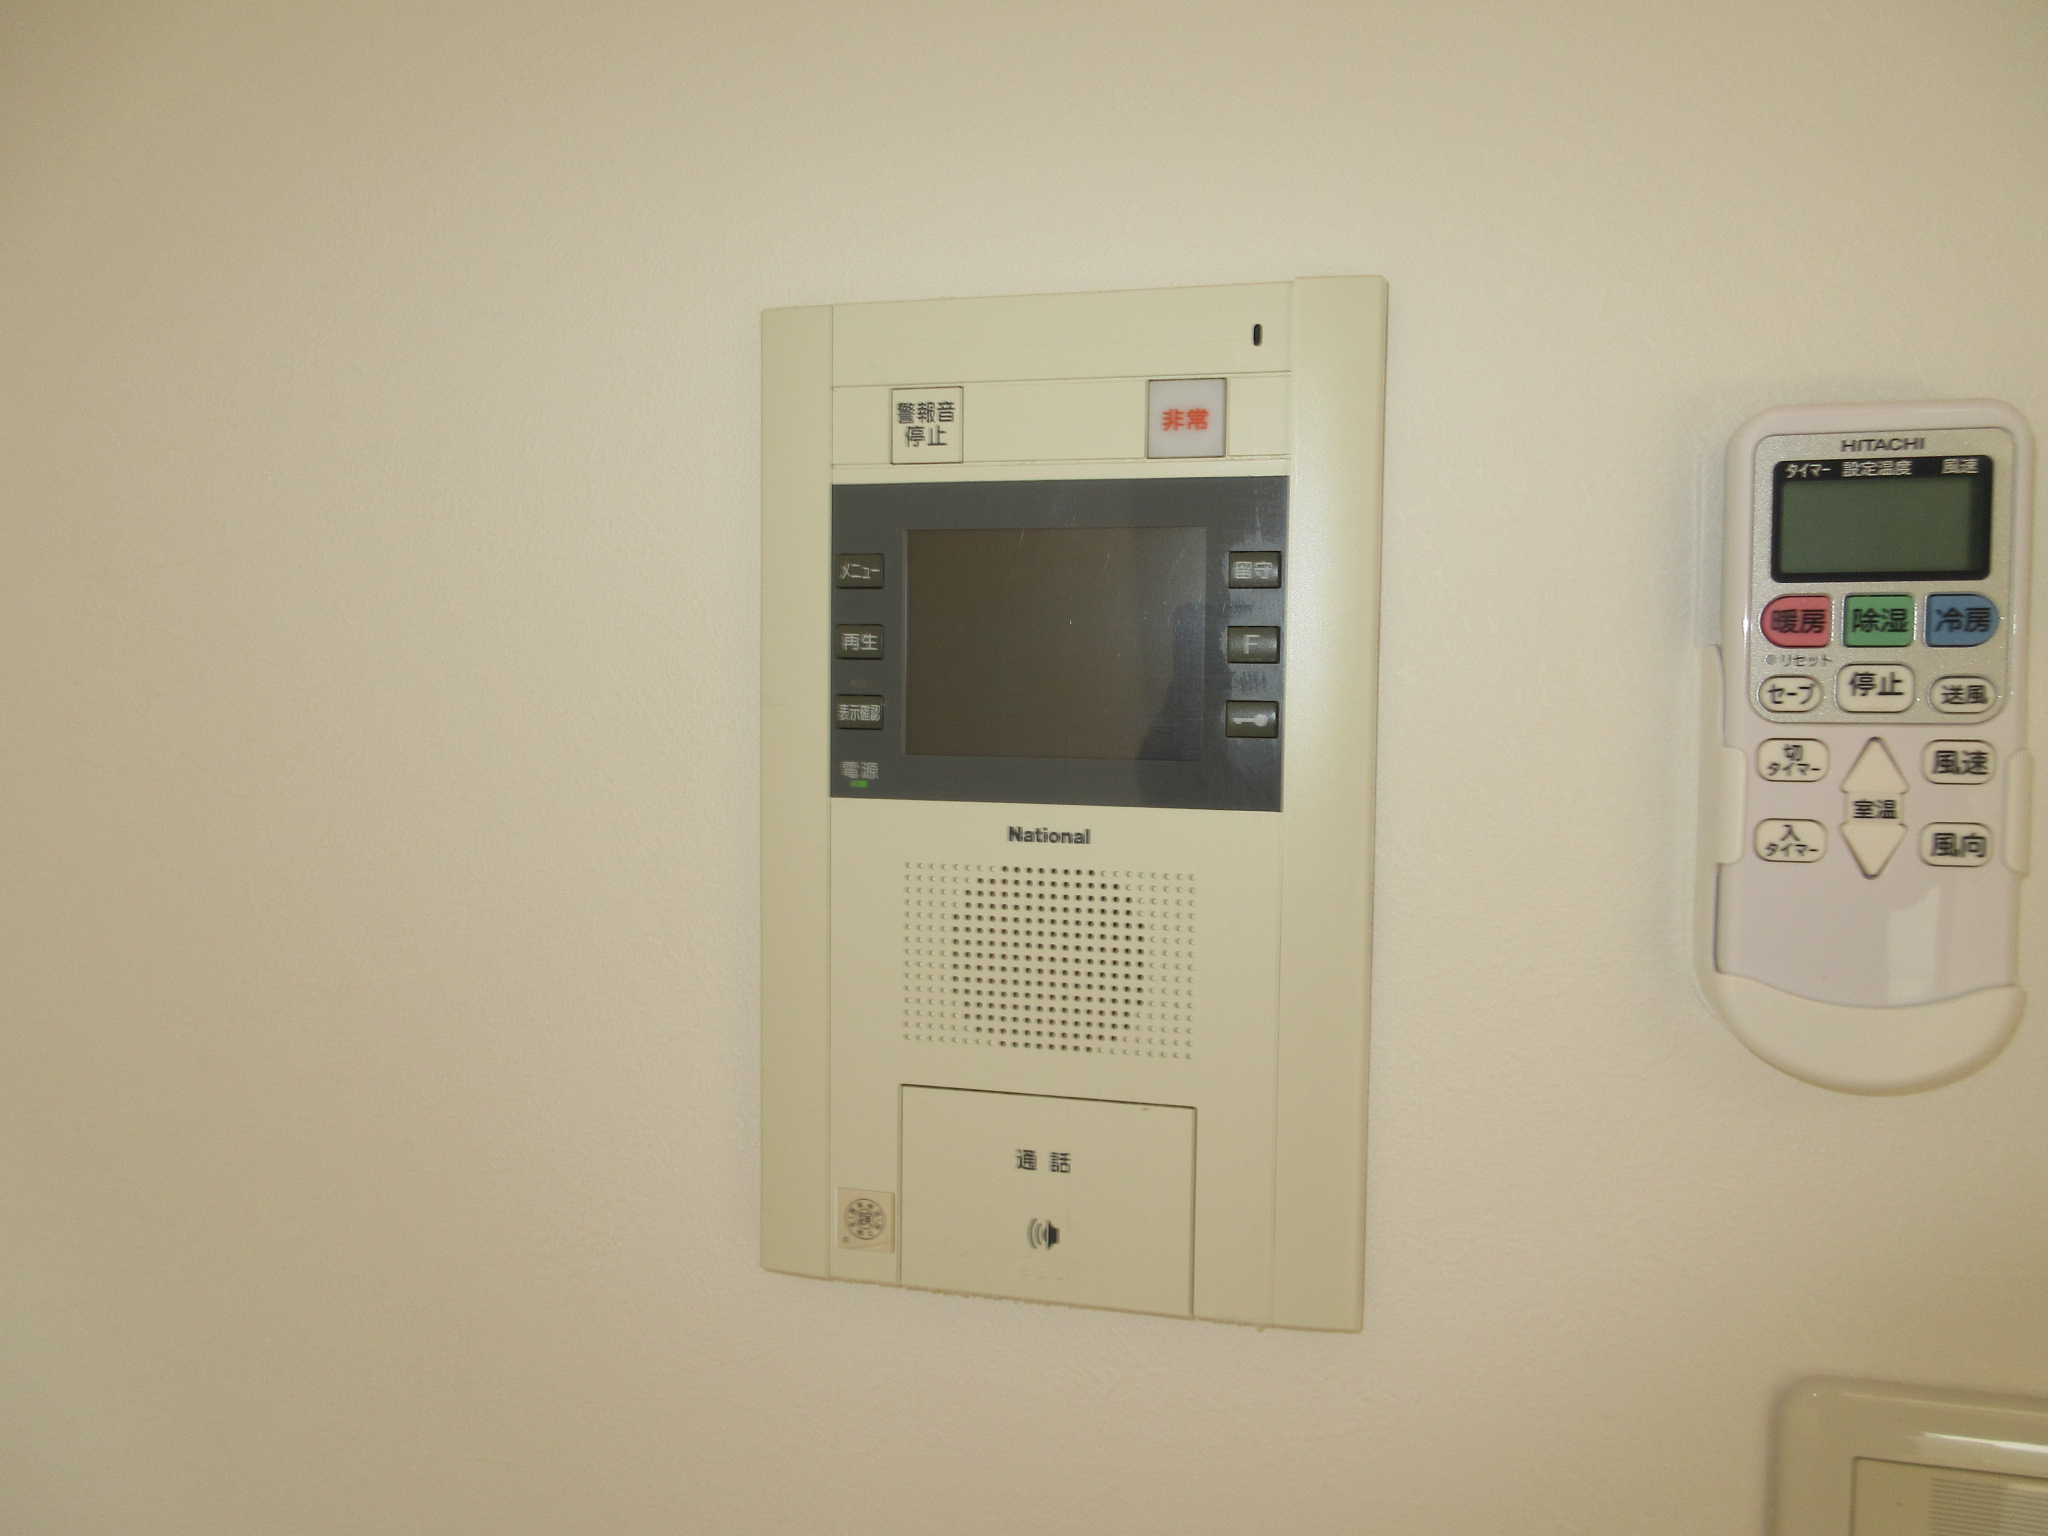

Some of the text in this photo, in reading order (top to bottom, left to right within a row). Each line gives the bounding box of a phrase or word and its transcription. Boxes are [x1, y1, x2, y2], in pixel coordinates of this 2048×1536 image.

[897, 401, 955, 423] 警報音
[1161, 408, 1209, 431] 非常
[904, 426, 947, 447] 停止
[1840, 437, 1925, 452] HITACHI
[1785, 462, 1831, 478] タイマー
[1841, 460, 1912, 477] 設定温度
[1940, 458, 1980, 475] 風速
[840, 562, 880, 580] メニュー
[1233, 561, 1273, 580] 留守
[1771, 608, 1826, 633] 暖房
[1852, 608, 1908, 633] 除湿
[1935, 607, 1992, 633] 冷房
[842, 632, 878, 651] 再生
[1243, 634, 1261, 655] F
[1778, 653, 1833, 667] リセット
[1848, 672, 1905, 697] 停止
[1940, 684, 1989, 706] 送風
[838, 704, 881, 722] 表示確認
[1782, 745, 1804, 761] 切
[1932, 750, 1989, 775] 風速
[840, 761, 879, 780] 電源
[1768, 763, 1821, 777] タイマー
[1852, 799, 1898, 820] 室温
[1008, 826, 1092, 845] National
[1780, 824, 1801, 842] 入
[1765, 843, 1819, 857] タイマー
[1930, 832, 1988, 858] 風向
